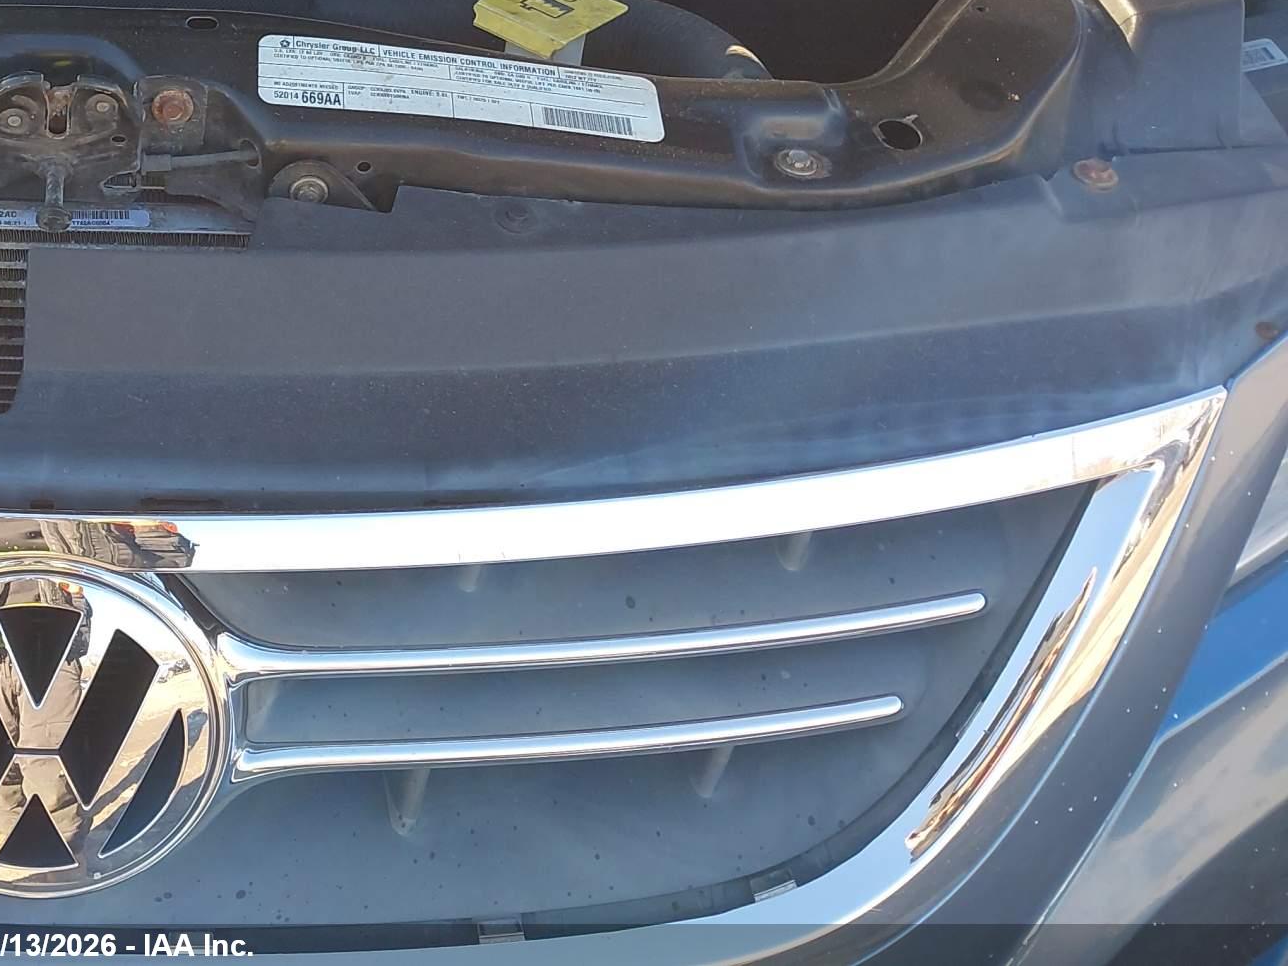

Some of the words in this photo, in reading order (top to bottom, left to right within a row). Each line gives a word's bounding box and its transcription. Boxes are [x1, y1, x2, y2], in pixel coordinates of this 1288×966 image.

[296, 40, 330, 51] Chrysler
[332, 43, 358, 54] Group
[359, 45, 376, 54] LLC
[382, 49, 416, 60] VEHICLE
[418, 53, 458, 64] EMISSION
[459, 57, 498, 69] CONTROL
[499, 62, 556, 76] INFORMATION
[273, 90, 300, 101] 52014
[301, 91, 342, 107] 669AA
